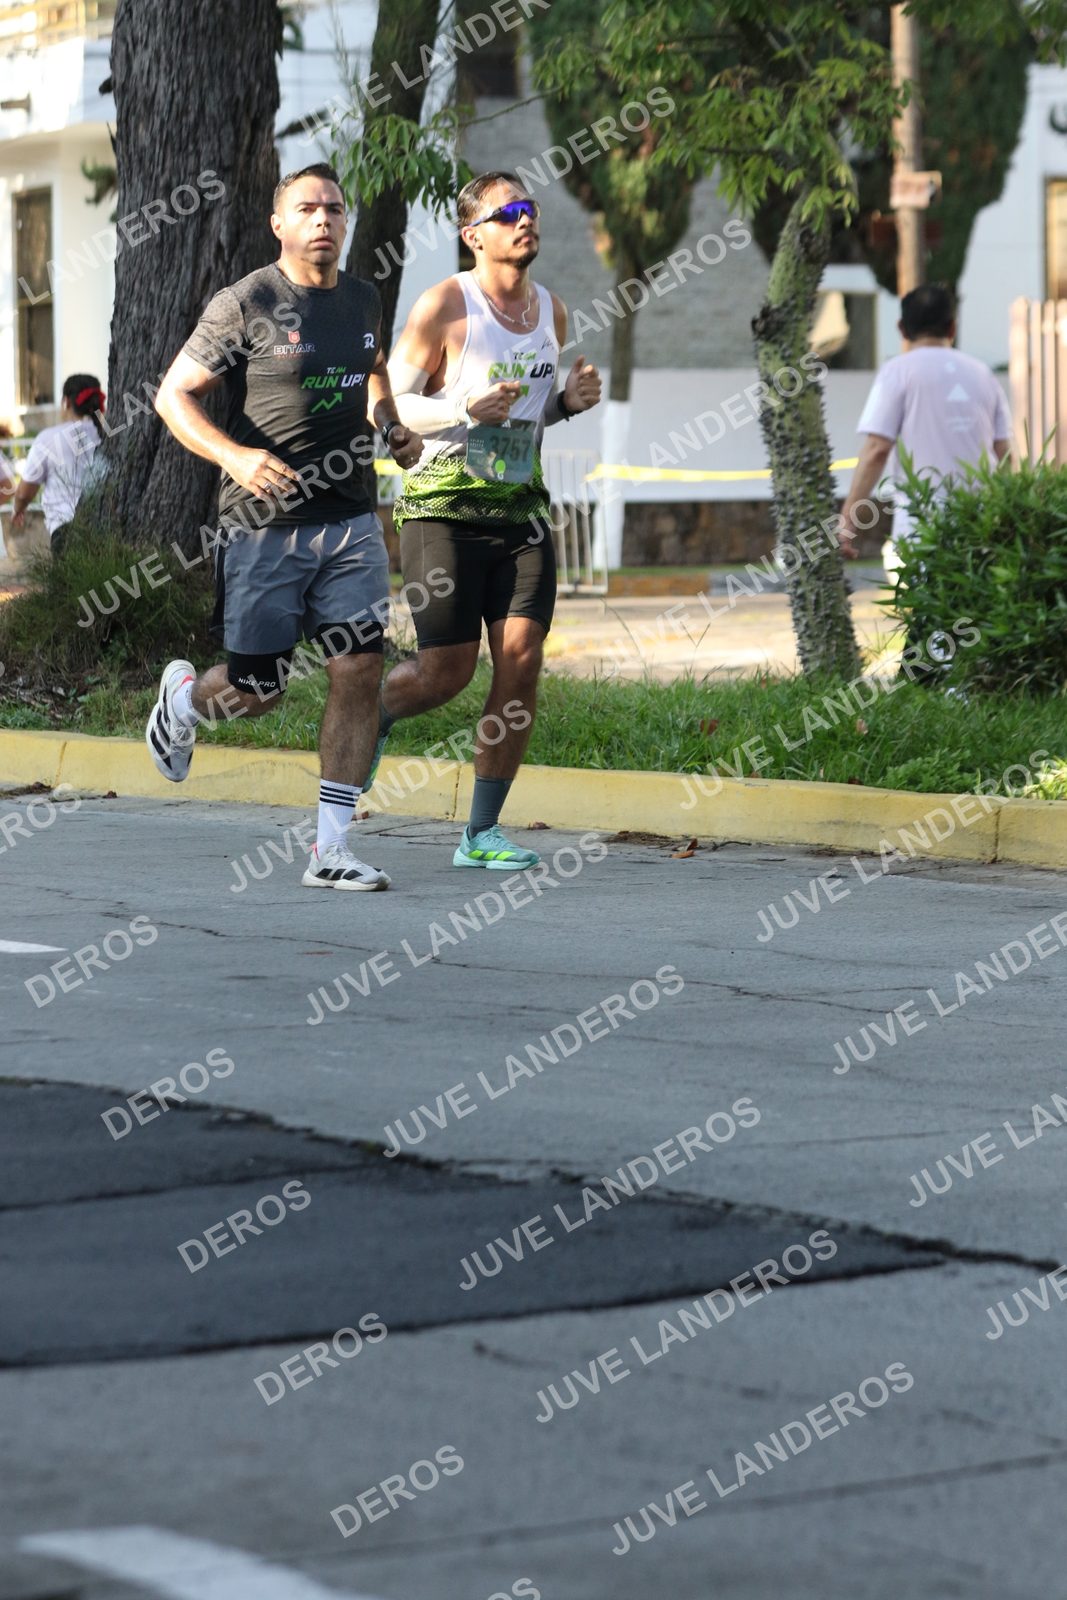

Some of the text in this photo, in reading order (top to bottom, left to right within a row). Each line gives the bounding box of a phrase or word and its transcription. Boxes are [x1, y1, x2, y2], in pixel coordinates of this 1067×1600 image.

[274, 342, 316, 355] BITAR
[488, 362, 527, 379] RUN
[301, 373, 366, 389] RUN UP!
[490, 435, 531, 463] 3757
[238, 677, 257, 686] NIKE
